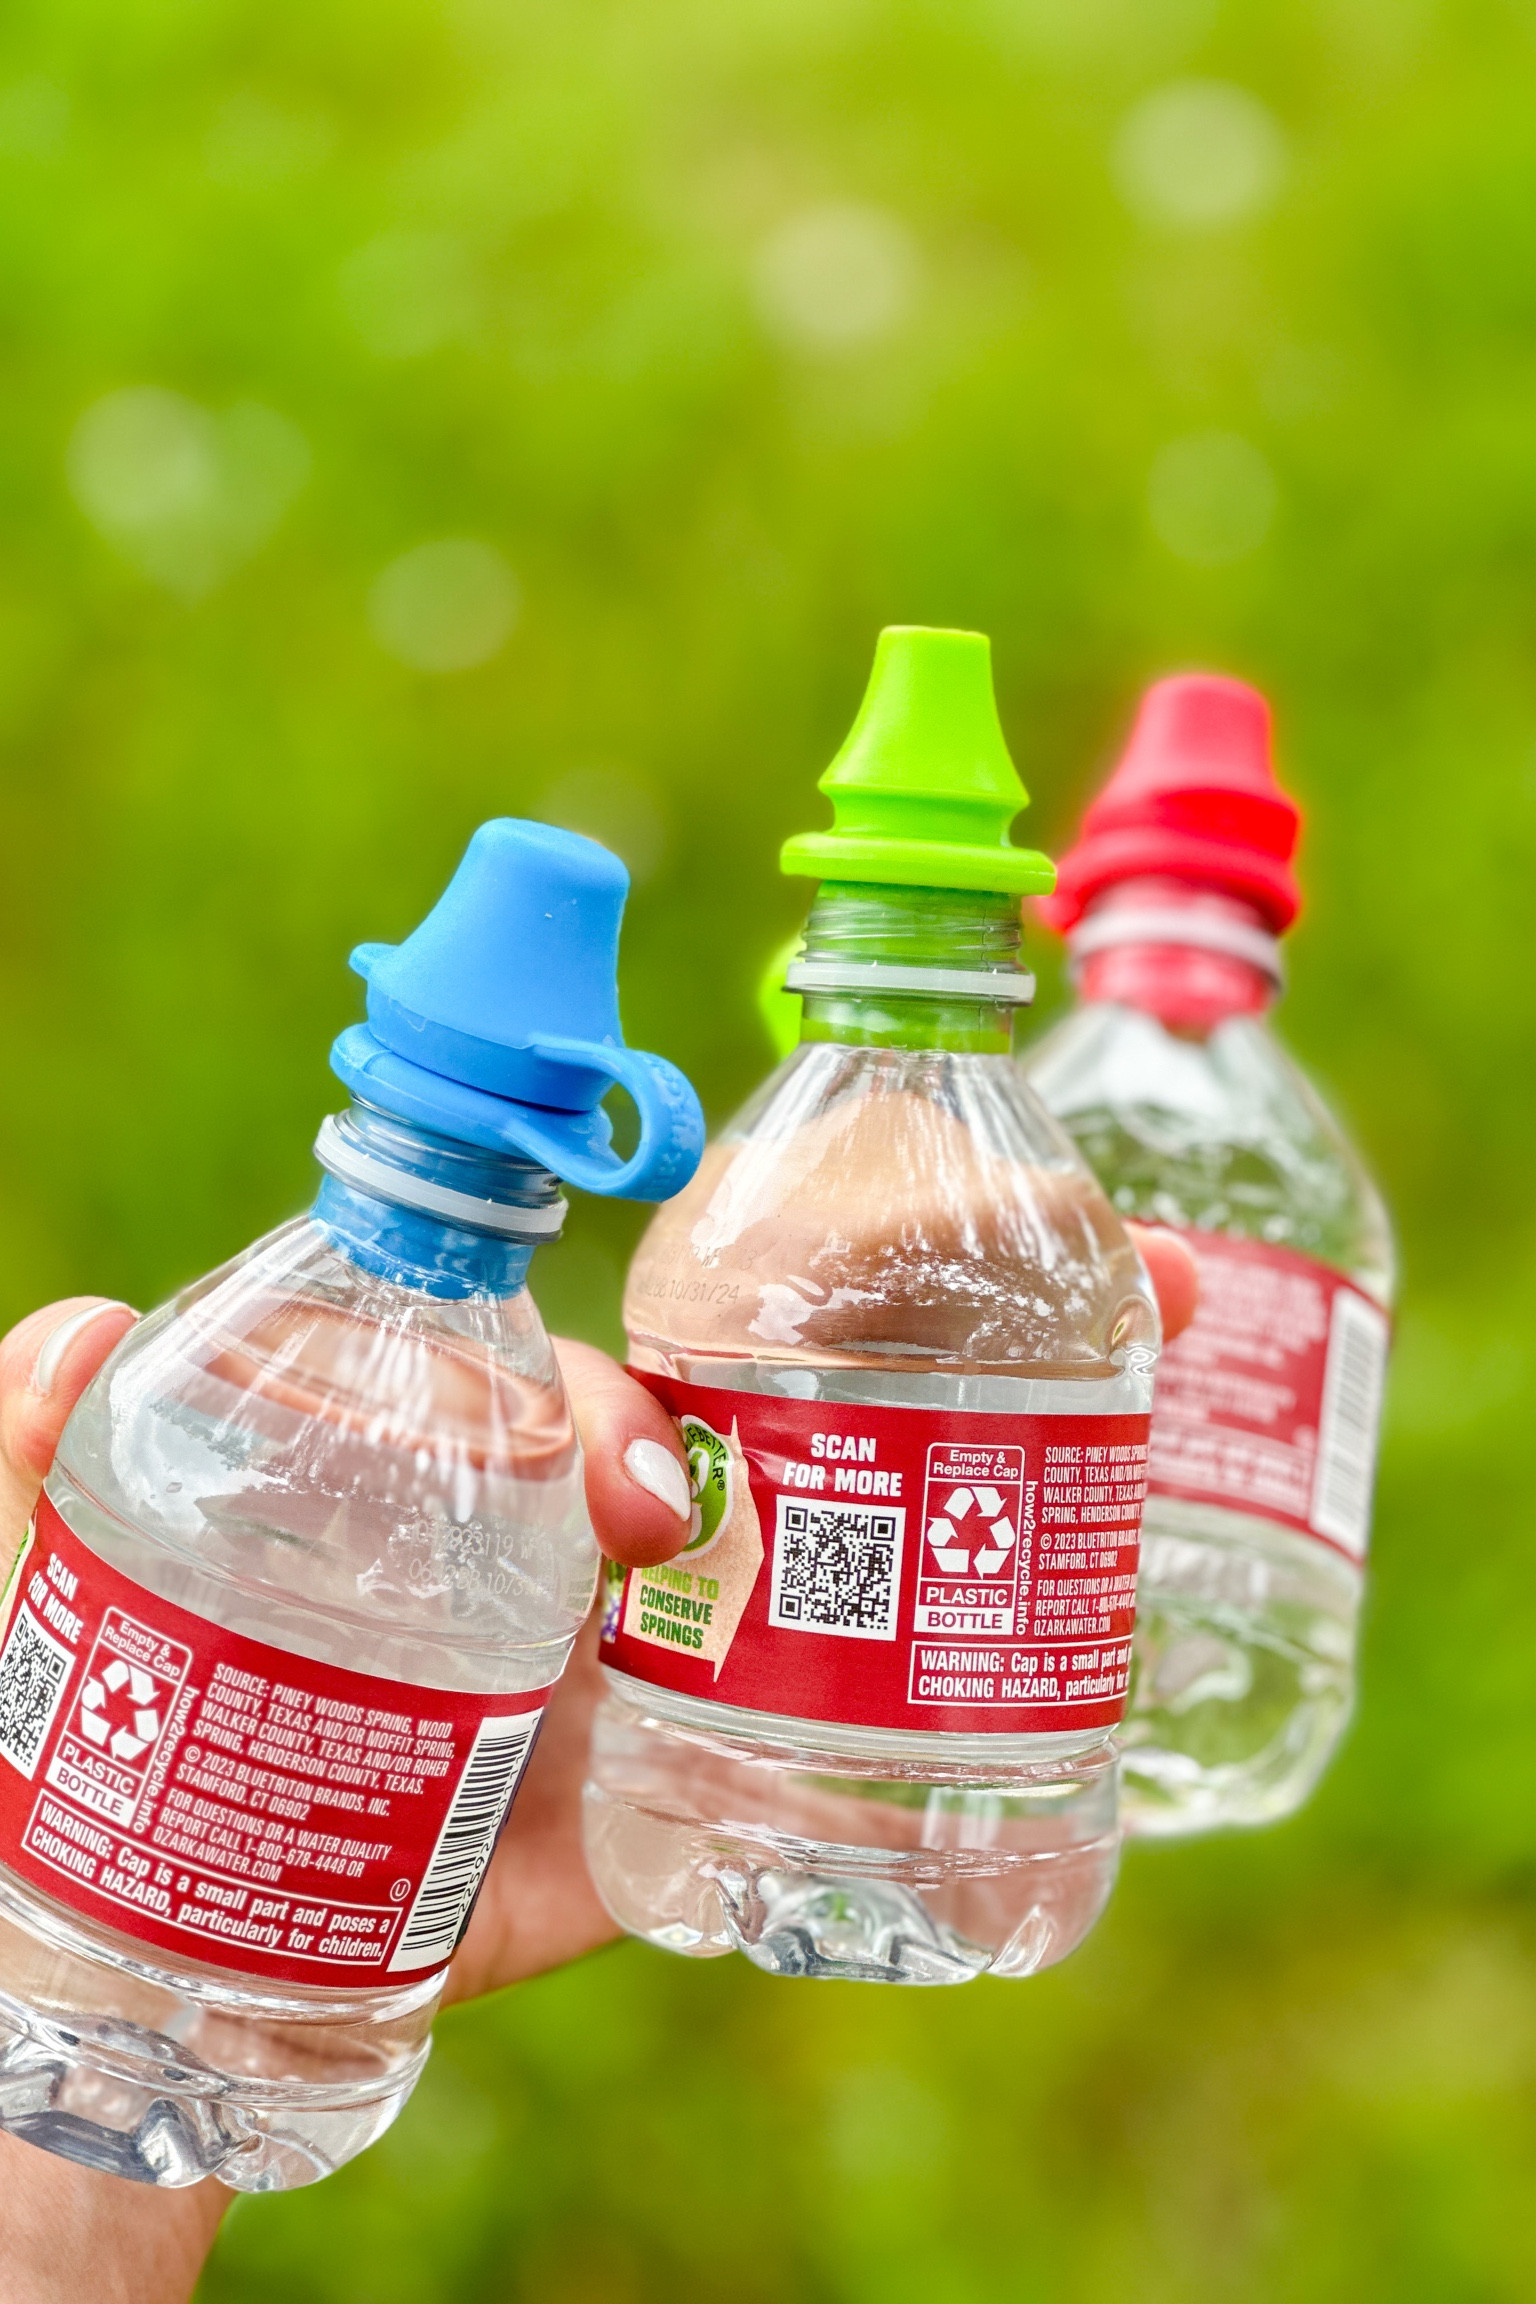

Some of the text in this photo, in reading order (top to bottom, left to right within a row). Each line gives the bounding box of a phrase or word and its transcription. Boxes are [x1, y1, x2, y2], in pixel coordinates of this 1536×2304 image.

[669, 1279, 740, 1304] 10/31/24
[810, 1432, 877, 1462] SCAN
[949, 1450, 1006, 1465] Empty &
[1045, 1446, 1084, 1464] SOURCE:
[1085, 1446, 1108, 1463] PINEY
[1109, 1445, 1131, 1462] WOODS
[782, 1461, 903, 1497] FOR MORE
[933, 1462, 1019, 1479] Replace Cap
[1043, 1466, 1082, 1485] COUNTY,
[1084, 1466, 1110, 1483] TEXAS
[1110, 1465, 1133, 1482] AND/OR
[1043, 1486, 1082, 1504] WALKER
[1083, 1485, 1114, 1503] COUNTY,
[1115, 1484, 1134, 1502] TEXAS
[1041, 1506, 1079, 1524] SPRING,
[1080, 1504, 1120, 1523] HENDERSON
[1016, 1481, 1038, 1636] how2recycle.info
[1040, 1533, 1052, 1550] ©
[1054, 1532, 1076, 1550] 2023
[1077, 1531, 1118, 1549] BLUETRITON
[47, 1553, 79, 1601] SCAN
[1038, 1552, 1088, 1570] STAMFORD,
[1089, 1551, 1100, 1569] CT
[641, 1565, 720, 1600] HELPING TO
[926, 1586, 1008, 1606] PLASTIC
[1037, 1579, 1055, 1597] FOR
[1056, 1577, 1100, 1597] QUESTIONS
[1100, 1577, 1109, 1593] OR
[28, 1570, 84, 1645] FOR MORE
[639, 1584, 713, 1625] CONSERVE
[927, 1611, 1003, 1629] BOTTLE
[1035, 1599, 1071, 1617] REPORT
[1071, 1598, 1090, 1616] CALL
[119, 1620, 171, 1658] Empty &
[640, 1611, 704, 1649] SPRINGS
[1034, 1615, 1111, 1636] OZARKAWATER.COM
[104, 1625, 181, 1678] Replace Cap
[920, 1649, 1005, 1672] WARNING:
[1011, 1652, 1038, 1676] Cap
[1043, 1651, 1055, 1672] is
[1059, 1654, 1068, 1671] a
[1071, 1648, 1099, 1670] small
[1101, 1647, 1116, 1672] part
[1117, 1644, 1128, 1665] and
[213, 1663, 453, 1739] SOURCE: PINEY WOODS SPRING, WOOD
[919, 1675, 994, 1698] CHOKING
[1001, 1677, 1061, 1700] HAZARD,
[1065, 1672, 1115, 1700] particularly
[1117, 1670, 1125, 1690] for
[201, 1700, 450, 1777] WALKER COUNTY, TEXAS AND/OR ROHER
[206, 1681, 455, 1759] COUNTY, TEXAS AND/OR MOFFIT SPRING,
[62, 1742, 135, 1795] PLASTIC
[133, 1685, 200, 1834] how2recycle.info
[193, 1719, 424, 1795] SPRING, HENDERSON COUNTY, TEXAS.
[56, 1766, 124, 1817] BOTTLE
[176, 1762, 310, 1821] STAMFORD, CT 06902
[185, 1745, 390, 1816] © 2023 BLUETRITON BRANDS, INC.
[159, 1806, 365, 1877] REPORT CALL 1-800-678-4448 OR
[166, 1787, 392, 1861] FOR QUESTIONS OR A WATER QUALITY
[40, 1800, 391, 1934] WARNING: Cap is a small part and poses a
[153, 1826, 282, 1882] OZARKAWATER.COM
[31, 1825, 383, 1958] CHOKING HAZARD, particularly for children.
